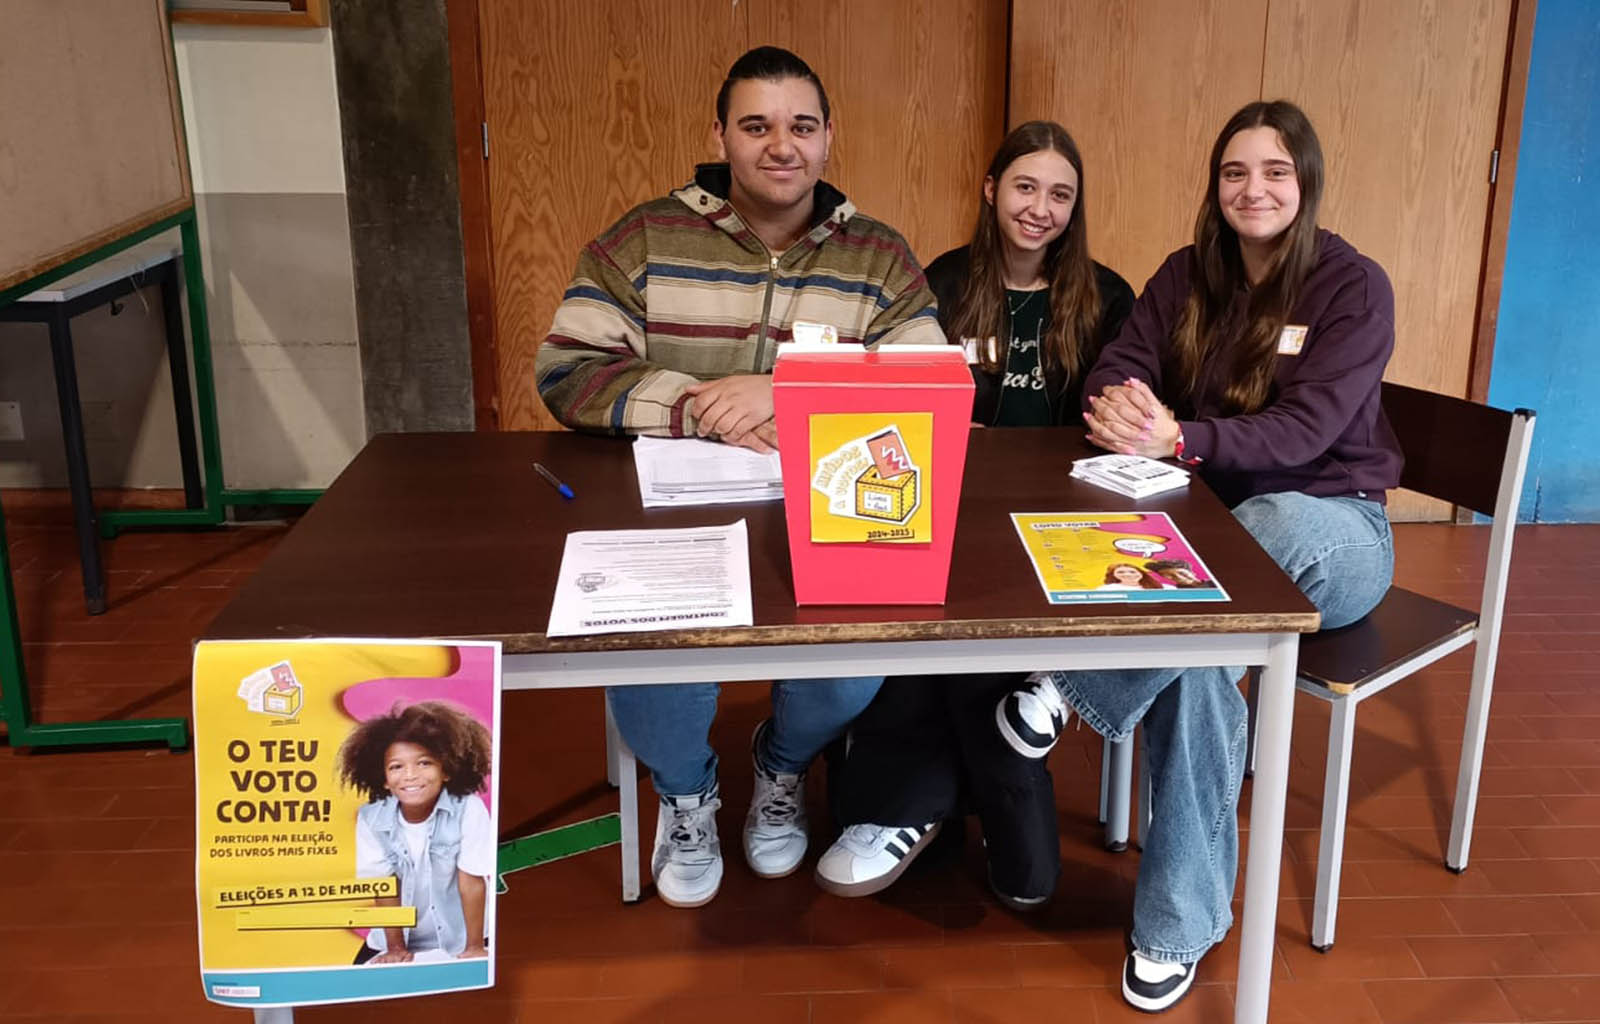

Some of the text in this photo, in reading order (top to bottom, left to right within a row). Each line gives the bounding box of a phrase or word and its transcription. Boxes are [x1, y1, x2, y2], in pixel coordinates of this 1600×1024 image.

[584, 619, 627, 628] VOTOS
[631, 616, 657, 624] DOS
[227, 740, 319, 763] O TEU
[230, 770, 318, 793] VOTO
[216, 800, 331, 824] CONTA!
[214, 831, 334, 845] PARTICIPA NA ELEIÇÃO
[210, 846, 338, 858] DOS LIVROS MAIS FIXES
[220, 881, 391, 905] ELEIÇÕES A 12 DE MARÇO
